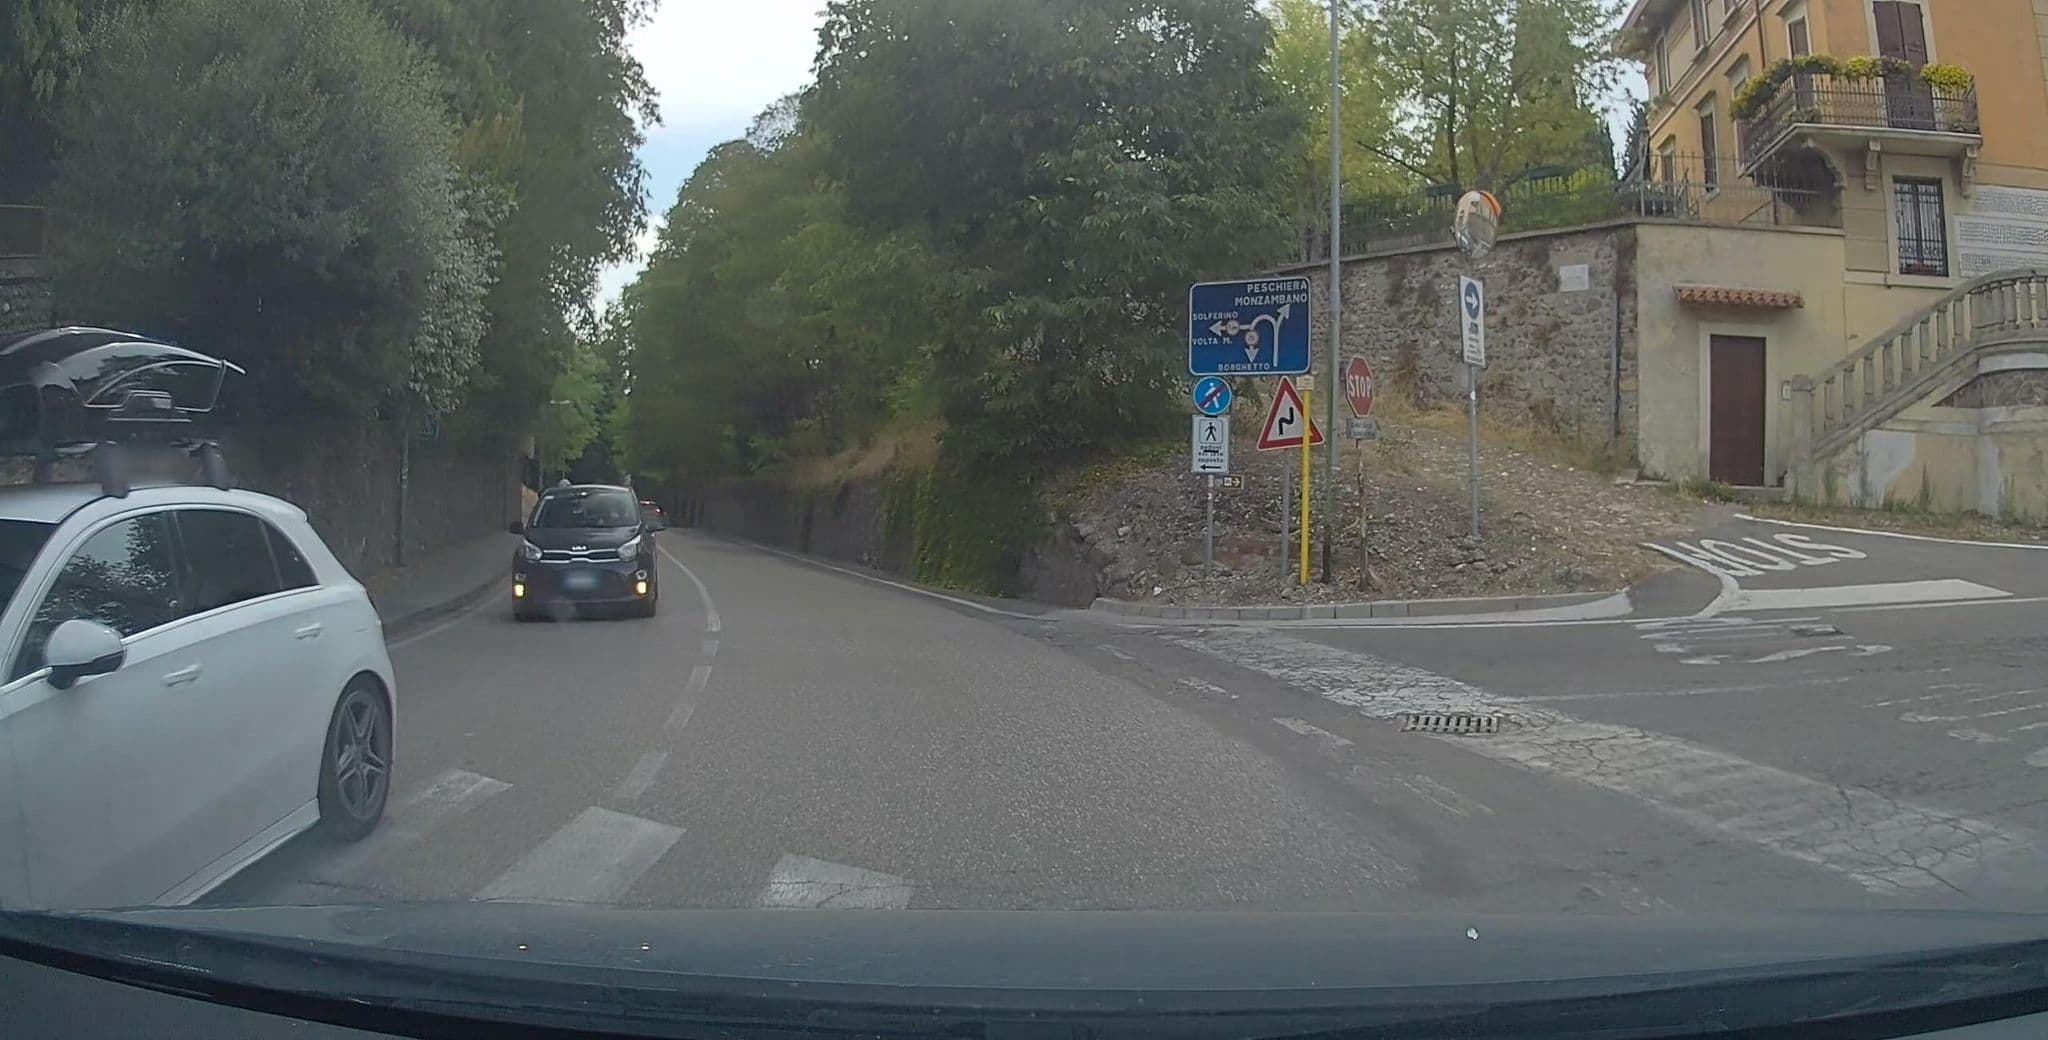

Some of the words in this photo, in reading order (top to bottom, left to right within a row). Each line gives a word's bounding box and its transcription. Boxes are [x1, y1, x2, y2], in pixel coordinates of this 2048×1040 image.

[1247, 281, 1308, 293] PESCHIERA
[1234, 293, 1308, 306] MONZAMBANO
[1192, 311, 1238, 321] SOLFERINO
[1192, 337, 1218, 346] VOLTA
[1218, 363, 1270, 371] BORGHETTO
[1348, 375, 1372, 399] STOP
